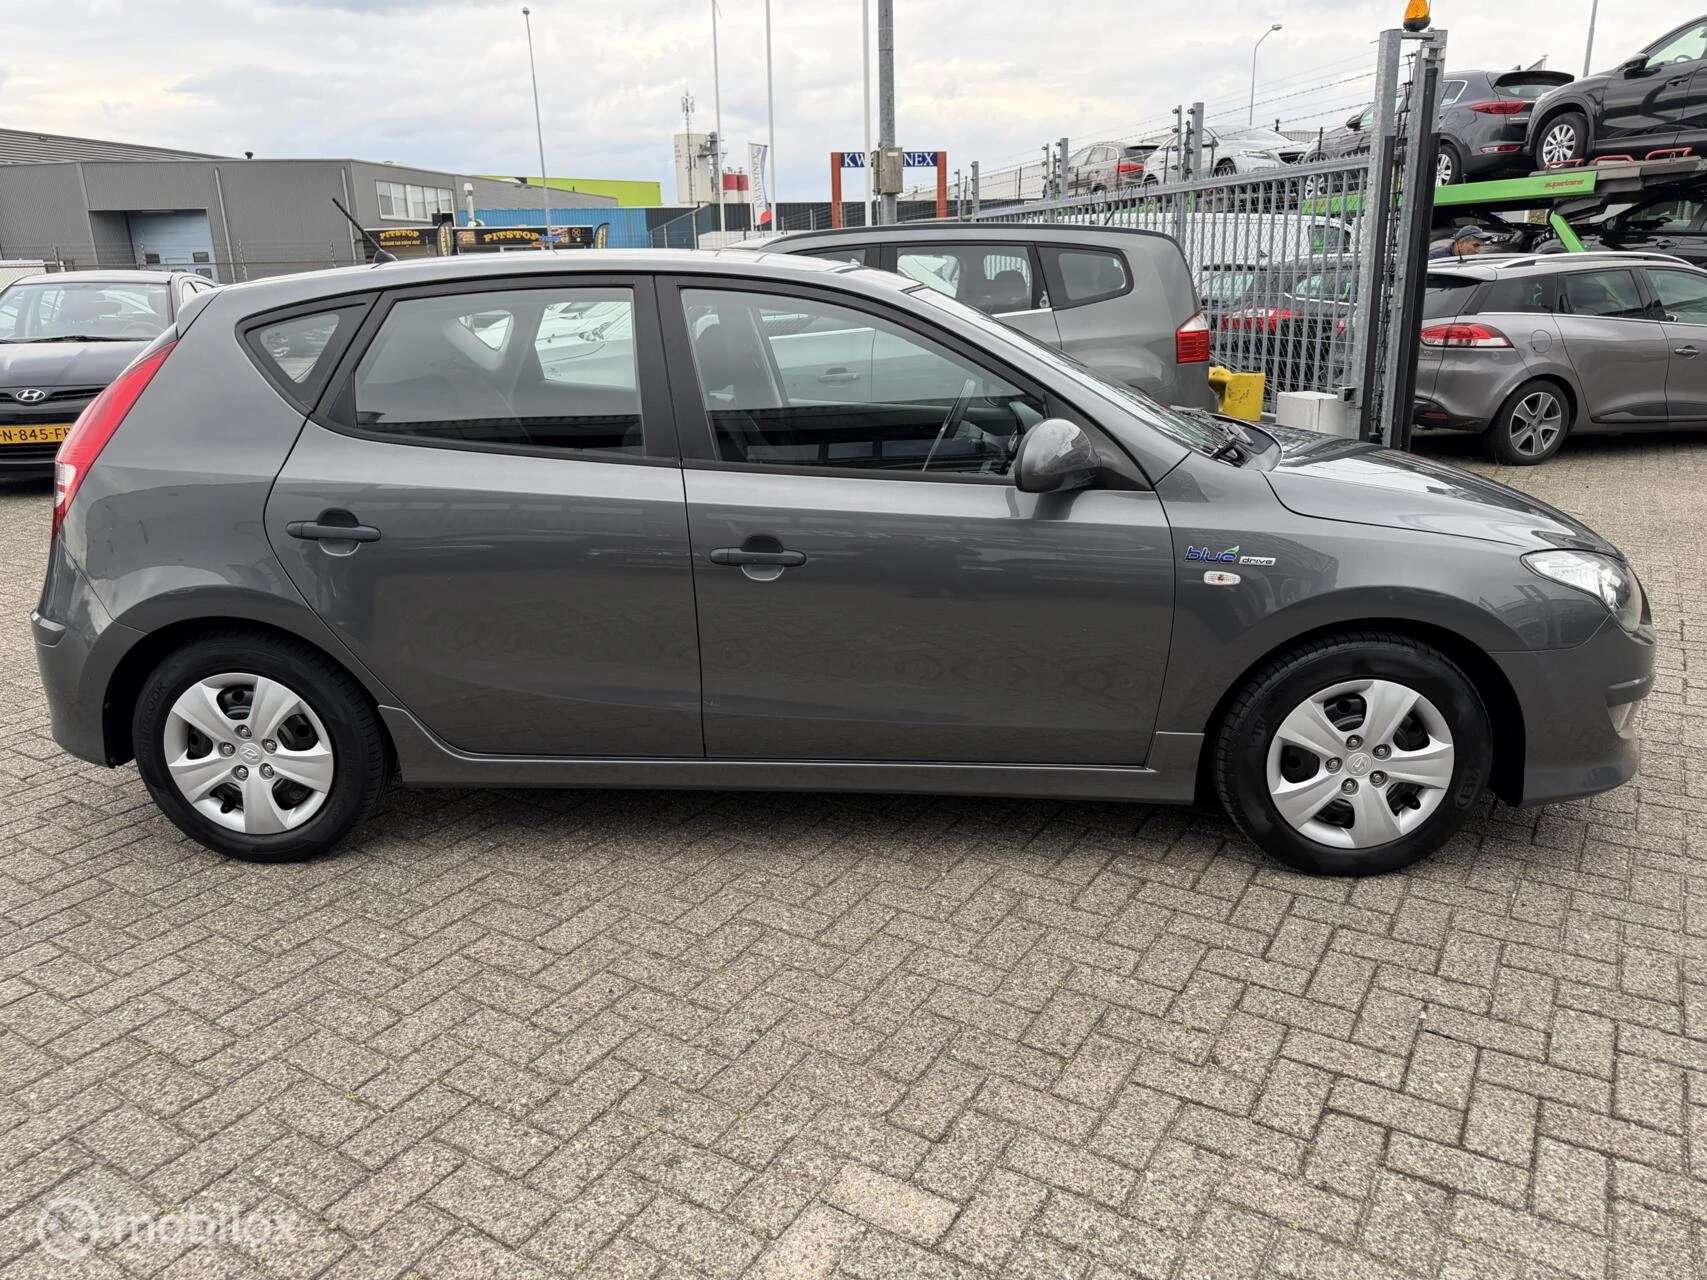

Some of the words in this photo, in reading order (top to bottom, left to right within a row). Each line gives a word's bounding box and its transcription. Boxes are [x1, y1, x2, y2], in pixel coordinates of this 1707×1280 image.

[844, 152, 934, 167] KWNEX
[379, 229, 420, 240] PITSTOP
[483, 230, 540, 243] PITSTOP
[1185, 545, 1238, 563] blue
[1241, 557, 1274, 565] drive
